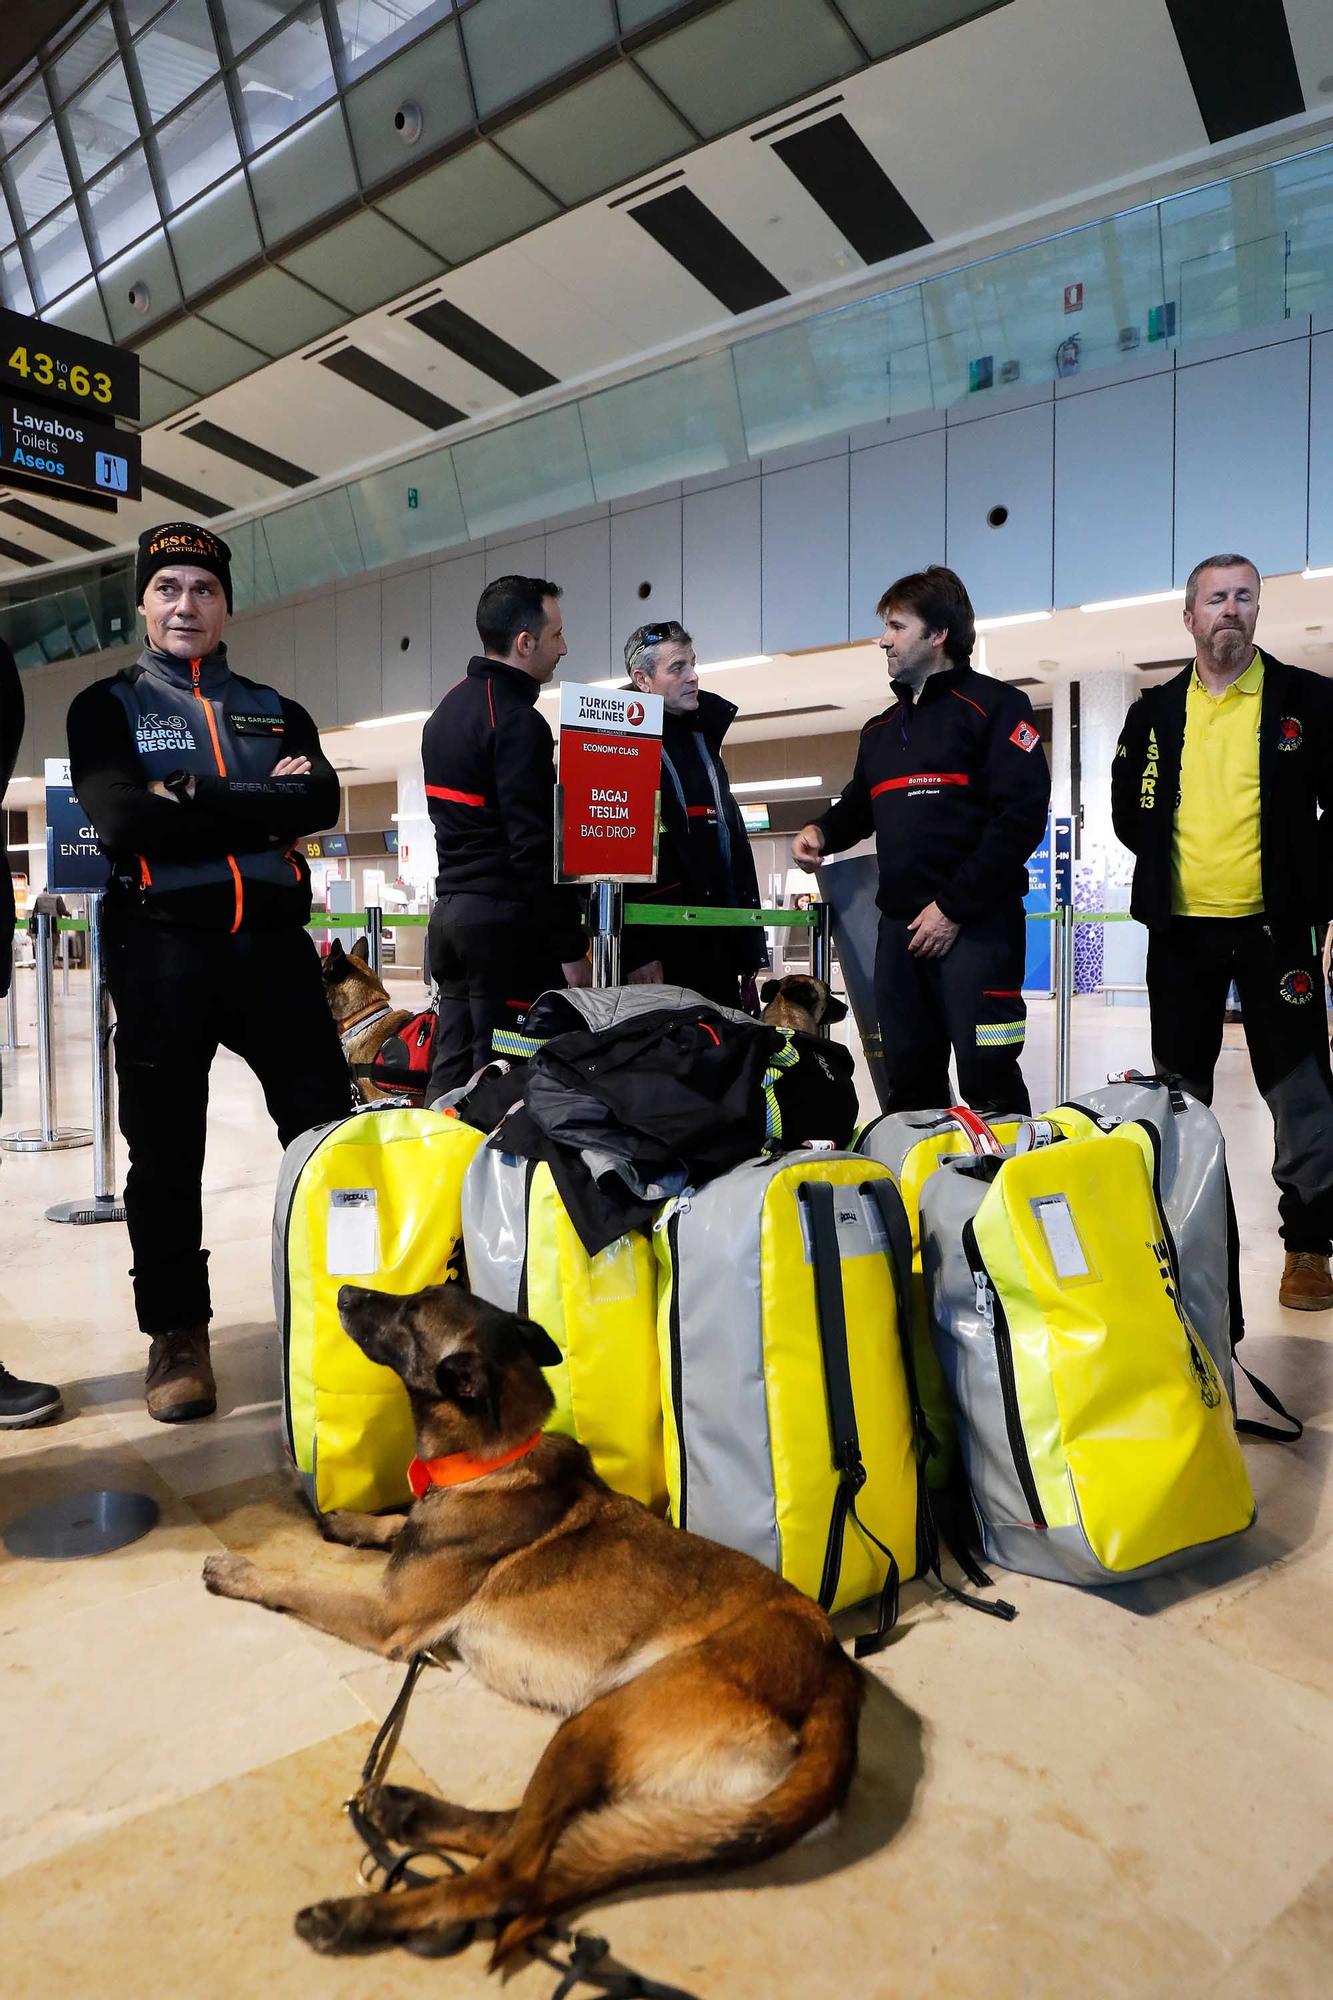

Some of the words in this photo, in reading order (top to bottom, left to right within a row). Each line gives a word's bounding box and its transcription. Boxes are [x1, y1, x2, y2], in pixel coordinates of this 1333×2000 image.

[8, 346, 54, 385] 43
[56, 359, 68, 374] to
[57, 378, 67, 391] a
[69, 365, 112, 403] 63
[13, 407, 84, 443] Lavabos
[12, 428, 58, 454] Toilets
[13, 447, 65, 475] Aseos
[579, 696, 625, 711] TURKISH
[137, 713, 188, 730] K-9
[578, 708, 625, 723] AIRLINES
[135, 729, 182, 741] SEARCH
[185, 731, 194, 740] &
[137, 739, 196, 753] RESCUE
[583, 743, 617, 755] ECONOMY
[618, 747, 639, 757] CLASS
[591, 788, 628, 803] BAGAJ
[1140, 795, 1155, 809] 13
[588, 804, 629, 820] TESLİM
[78, 825, 99, 839] Gİ
[581, 824, 604, 838] BAG
[606, 825, 636, 839] DROP
[306, 843, 321, 857] 59
